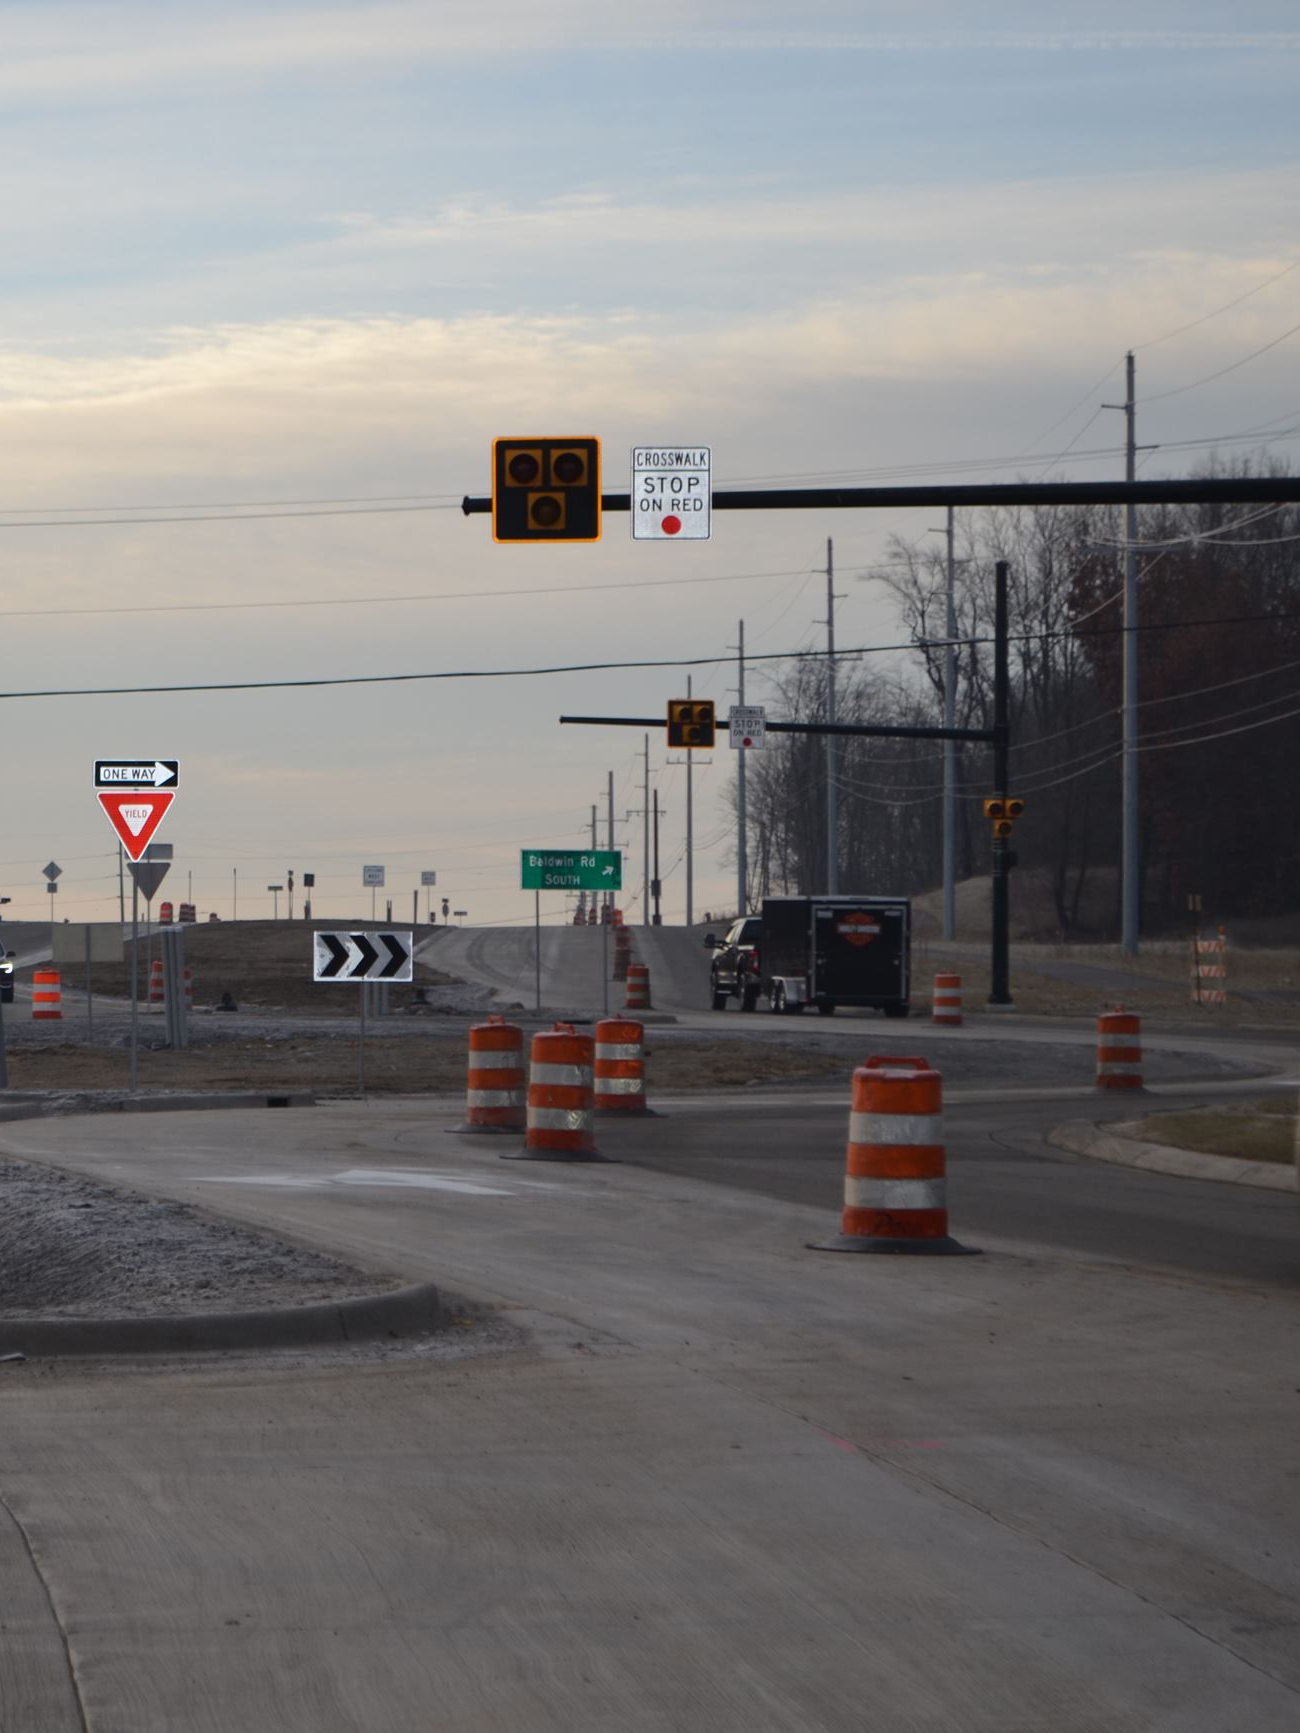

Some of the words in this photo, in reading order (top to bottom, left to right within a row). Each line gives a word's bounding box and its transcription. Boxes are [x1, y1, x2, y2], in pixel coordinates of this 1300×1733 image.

[636, 452, 707, 467] CROSSWALK
[643, 476, 700, 494] STOP
[639, 498, 663, 513] ON
[670, 498, 704, 512] RED
[734, 719, 761, 728] STOP
[747, 729, 762, 737] RED
[103, 768, 128, 780] ONE
[132, 768, 156, 780] WAY
[124, 809, 148, 819] YIELD
[528, 855, 574, 867] Baldwin
[580, 855, 596, 867] Rd
